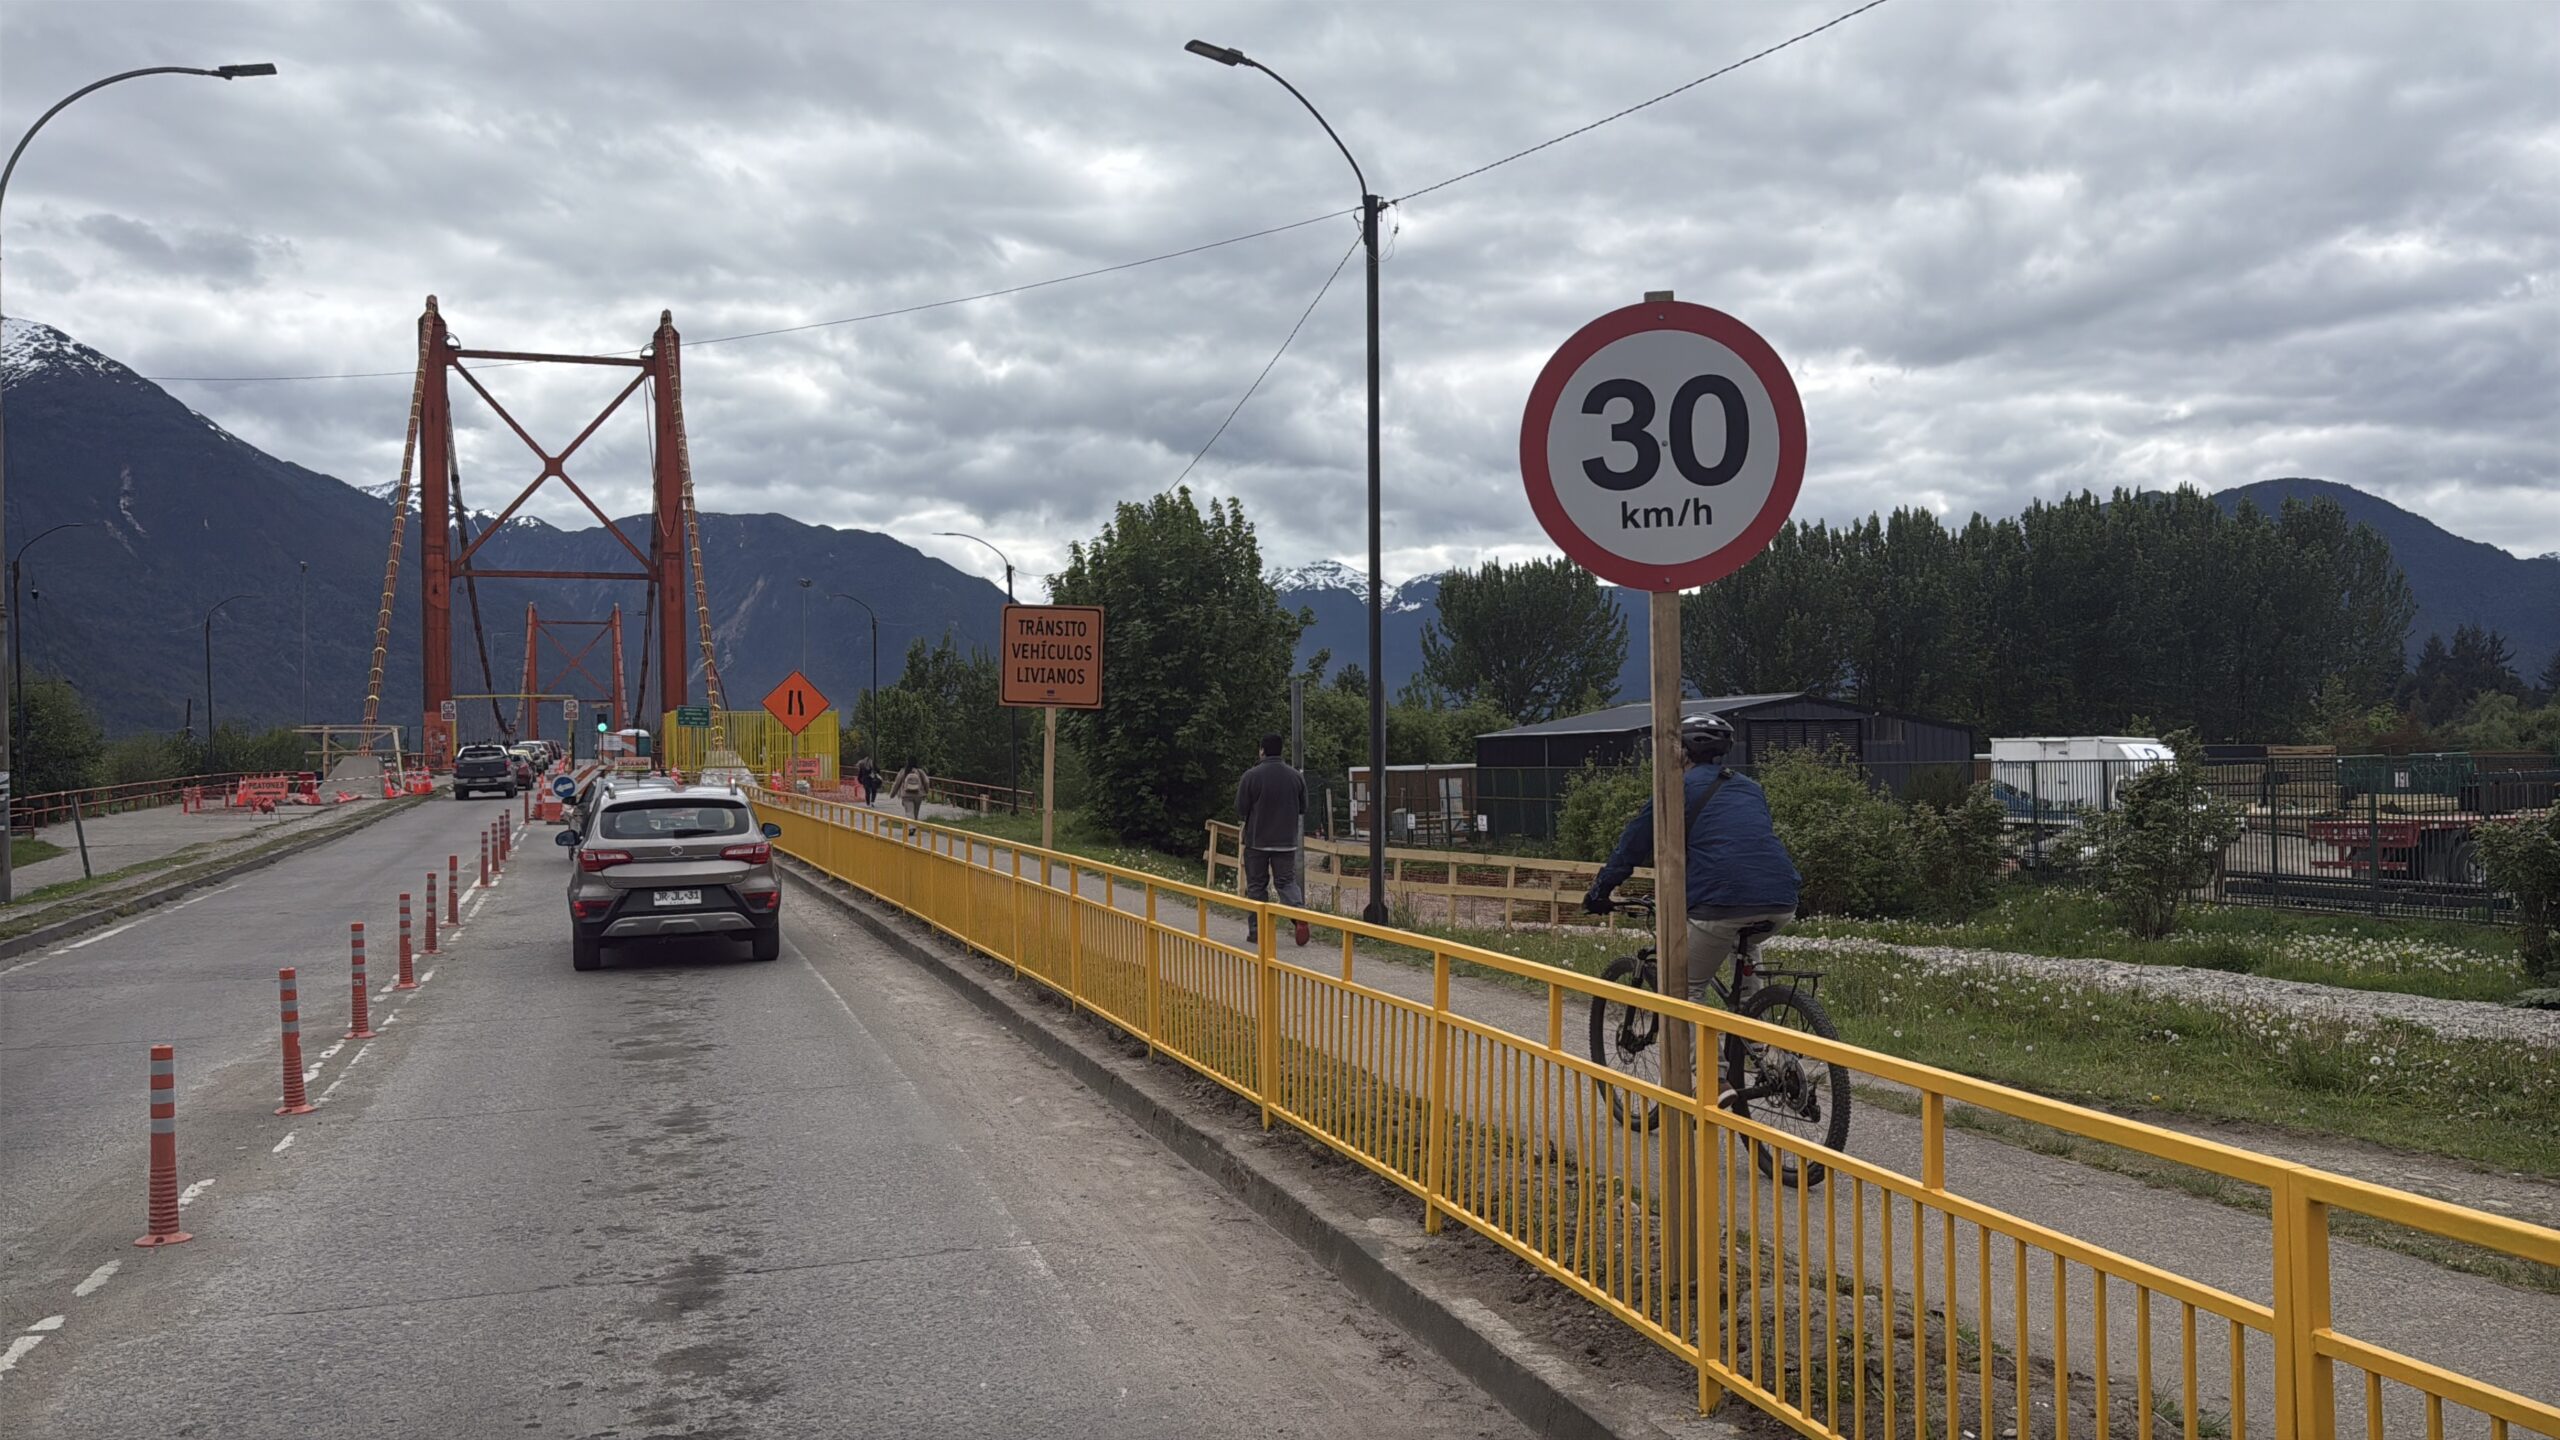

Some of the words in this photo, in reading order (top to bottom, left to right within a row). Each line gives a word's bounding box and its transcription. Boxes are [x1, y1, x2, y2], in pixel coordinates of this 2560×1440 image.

[1581, 374, 1750, 491] 30
[1621, 497, 1713, 529] km/h
[1018, 616, 1087, 637] TRÁNSITO
[1011, 640, 1092, 661] VEHÍCULOS
[1016, 667, 1085, 685] LIVIANOS
